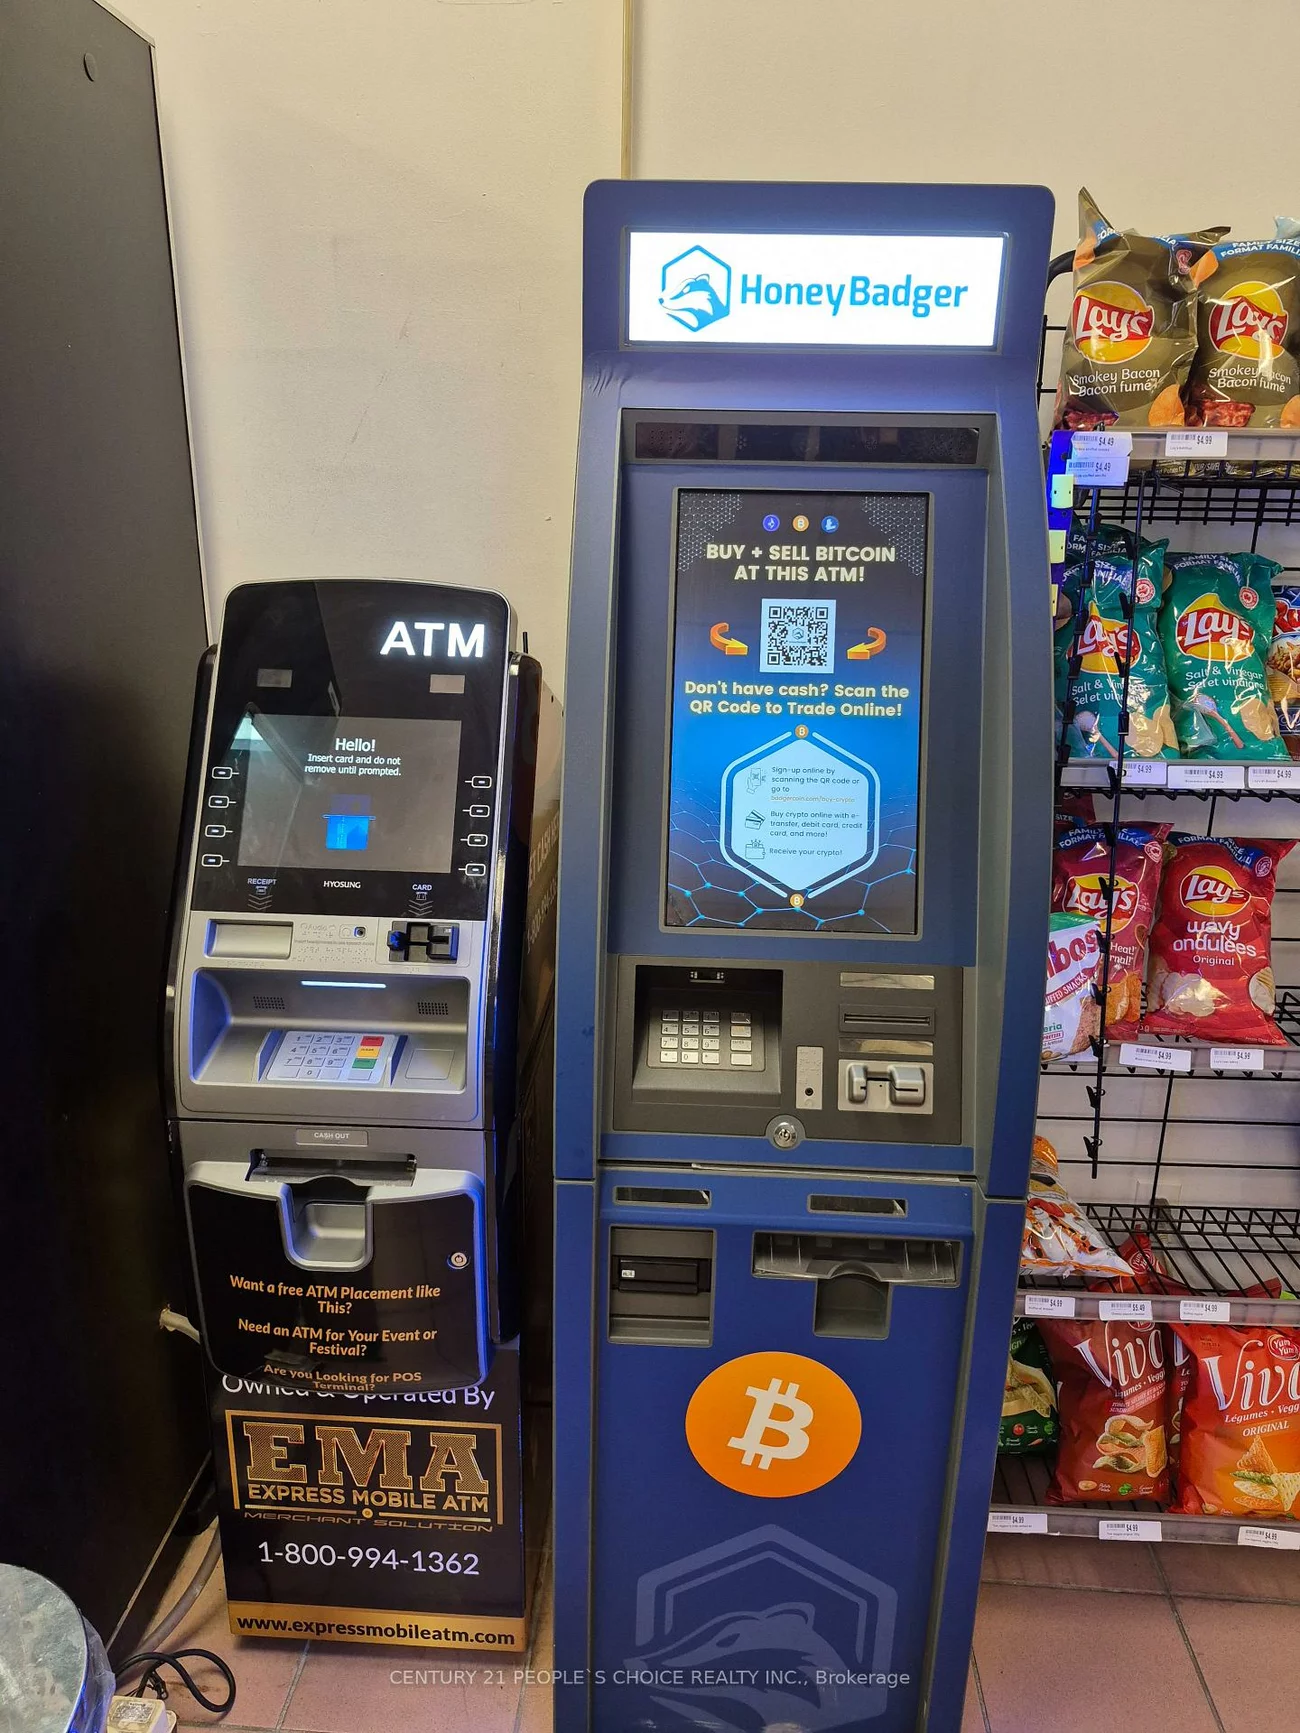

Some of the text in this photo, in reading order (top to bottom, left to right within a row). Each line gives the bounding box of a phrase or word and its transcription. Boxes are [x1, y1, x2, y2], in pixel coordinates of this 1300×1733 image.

[1220, 244, 1265, 257] FORMAT
[741, 274, 968, 318] HoneyBadger
[1075, 296, 1149, 342] Lay's
[1216, 298, 1284, 341] Lay's
[1073, 368, 1160, 386] Smokey Bacon
[1209, 364, 1259, 379] Smokey
[1079, 379, 1152, 397] Bacon fumé
[1217, 377, 1286, 393] Bacon fumé
[1098, 436, 1114, 446] $4.49
[1196, 435, 1212, 445] $4.99
[1095, 462, 1111, 472] $4.49
[706, 544, 746, 560] BUY
[769, 545, 810, 561] SELL
[815, 546, 896, 562] BITCOIN
[1174, 559, 1212, 570] FORMAT
[734, 565, 865, 582] AT THIS ATM!
[379, 620, 486, 659] ATM
[1185, 667, 1209, 681] Salt
[1212, 666, 1222, 676] &
[1071, 679, 1104, 696] Salt &
[1207, 677, 1219, 687] et
[685, 681, 910, 699] Don't have cash? Scan the
[1089, 692, 1101, 702] et
[690, 700, 902, 717] QR Code to Trade Online!
[335, 737, 376, 752] Hello!
[307, 753, 401, 765] Insert card and do not
[304, 765, 402, 777] remove until prompted.
[771, 766, 801, 775] Sign-up
[1137, 764, 1152, 774] $4.99
[1208, 769, 1224, 779] $4.99
[1276, 769, 1292, 779] $4.99
[771, 776, 805, 785] scanning
[771, 785, 790, 794] go to
[770, 810, 784, 818] Buy
[785, 811, 809, 819] crypto
[810, 811, 833, 819] online
[1059, 833, 1096, 848] FORMAT
[769, 847, 797, 855] Receive
[798, 849, 815, 857] your
[247, 877, 277, 886] RECEIPT
[323, 880, 361, 889] HYOSUNG
[412, 883, 432, 891] CARD
[1185, 875, 1246, 904] Lay's
[1186, 920, 1241, 941] wavy
[1193, 954, 1235, 967] Original
[1157, 1051, 1172, 1061] $4.99
[1237, 1051, 1251, 1060] $4.99
[313, 1131, 351, 1141] CASH OUT
[229, 1274, 441, 1300] Want a free ATM Placement like
[317, 1300, 353, 1315] This?
[1132, 1303, 1145, 1312] $5.49
[1204, 1304, 1218, 1312] $4.99
[238, 1318, 438, 1343] Need an ATM for Your Event or
[309, 1341, 368, 1358] Festival?
[1273, 1339, 1291, 1349] Yum
[1278, 1346, 1296, 1356] Yum
[263, 1364, 423, 1385] Are you Looking for POS
[312, 1380, 376, 1392] Terminal?
[463, 1385, 495, 1411] By
[1224, 1409, 1269, 1424] Légumes
[1242, 1420, 1290, 1437] ORIGINAL
[243, 1420, 490, 1495] EMA
[248, 1482, 489, 1513] EXPRESS MOBILE ATM
[244, 1510, 493, 1533] MERCHANT SOLUTION
[1011, 1515, 1025, 1524] $4.99
[1125, 1523, 1139, 1532] $4.99
[1264, 1531, 1278, 1541] $4.99
[258, 1540, 480, 1576] 1-800-994-1362
[236, 1614, 516, 1646] www.expressmobileatm.com
